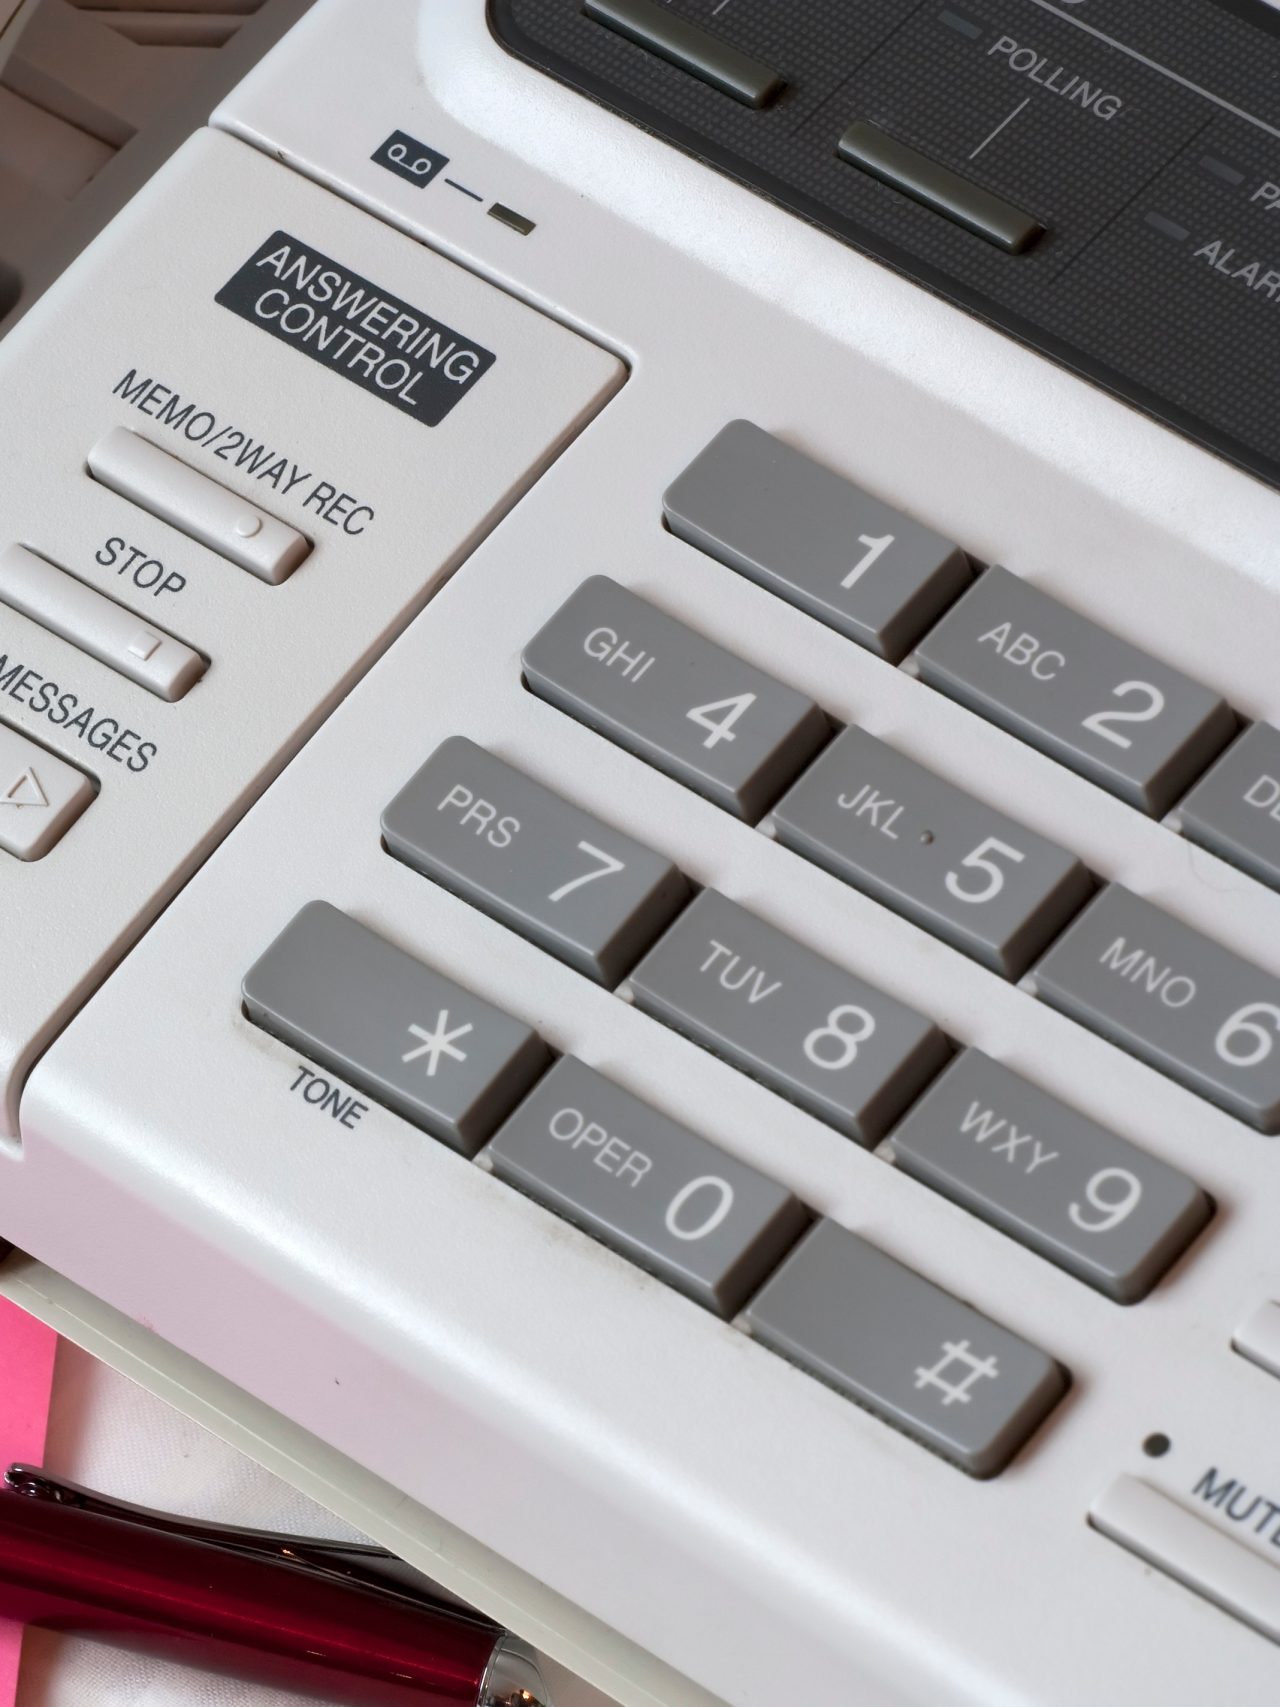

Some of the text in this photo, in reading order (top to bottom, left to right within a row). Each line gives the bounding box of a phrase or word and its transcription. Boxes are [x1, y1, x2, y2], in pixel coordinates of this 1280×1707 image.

[987, 35, 1122, 121] POLLING
[254, 245, 481, 385] ANSWERING
[1193, 240, 1280, 303] ALAR
[252, 289, 425, 406] CONTROL
[112, 368, 375, 536] MEMO/2WAY REC
[95, 537, 187, 597] STOP
[839, 533, 896, 590] 1
[583, 626, 758, 750] GHI 4
[977, 621, 1165, 750] ABC 2
[436, 783, 626, 903] PRS 7
[836, 784, 1026, 904] JKL 5
[1242, 774, 1280, 822] D
[699, 939, 877, 1071] TUV 8
[1098, 936, 1280, 1067] MNO 6
[289, 1065, 369, 1130] TONE
[548, 1107, 735, 1242] OPER 0
[959, 1100, 1143, 1233] WXY 9
[913, 1339, 1000, 1407] #
